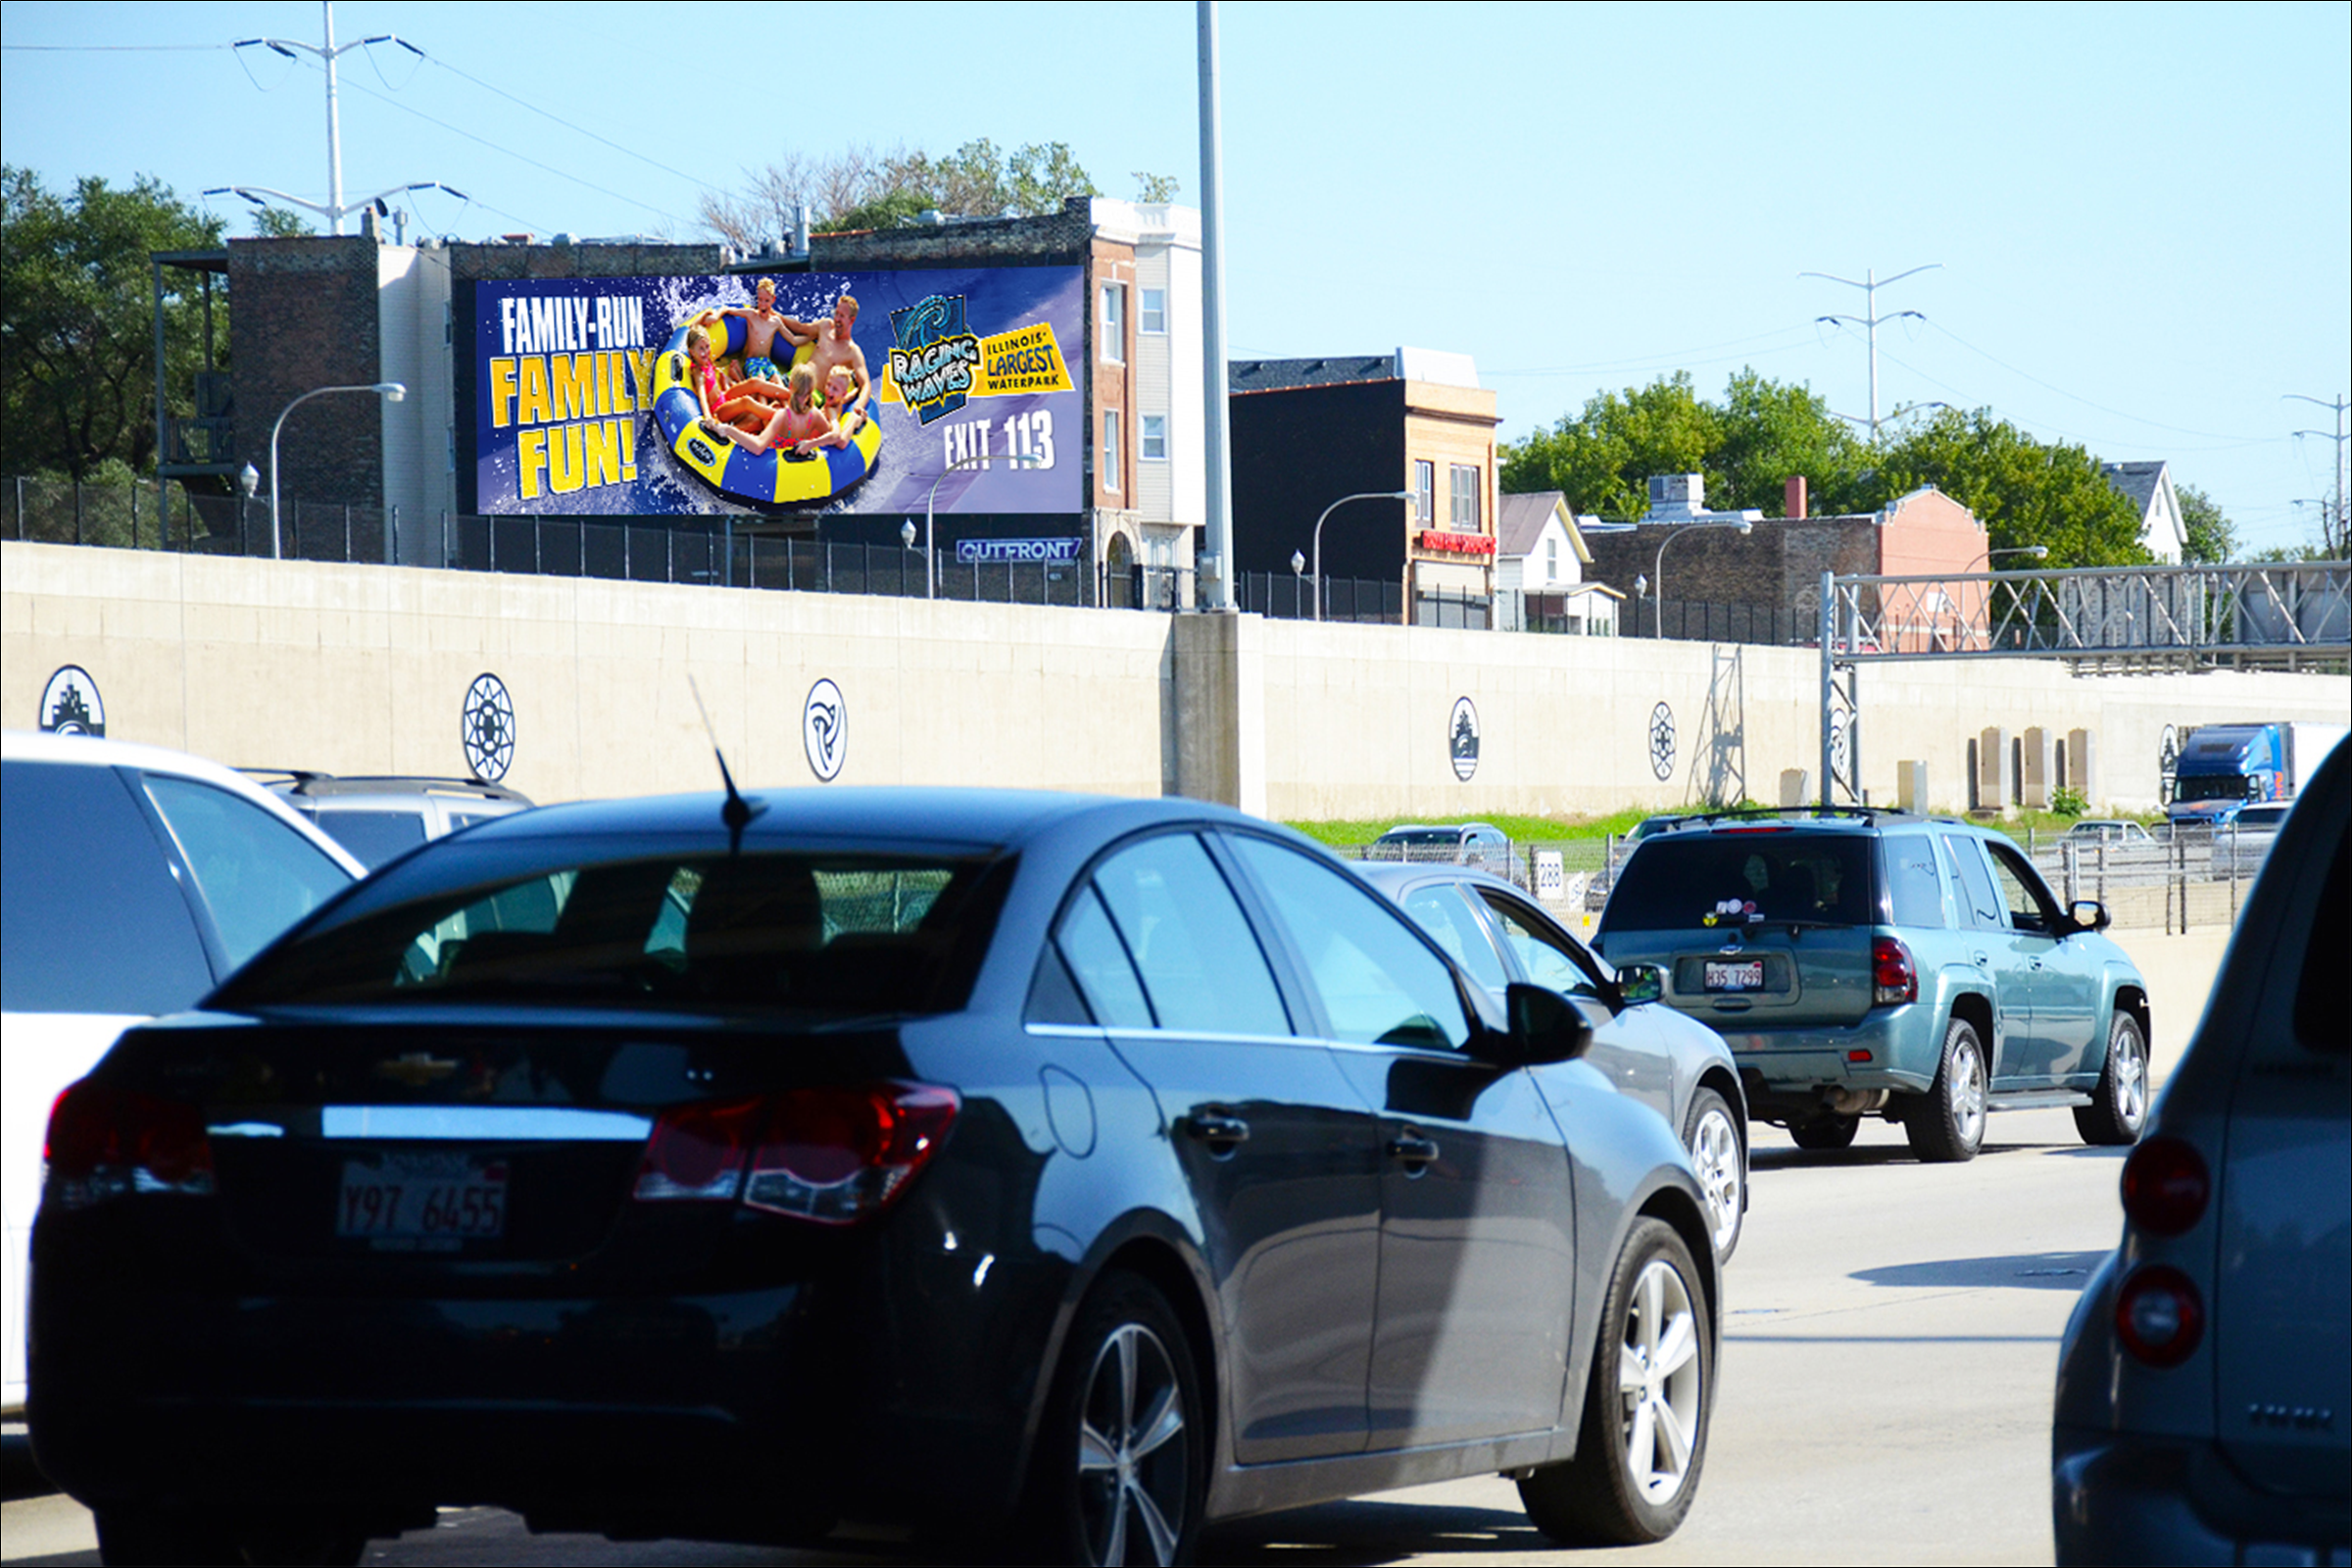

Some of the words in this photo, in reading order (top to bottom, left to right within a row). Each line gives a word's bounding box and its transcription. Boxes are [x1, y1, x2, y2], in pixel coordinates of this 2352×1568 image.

[499, 296, 644, 354] FAMILY-RUN
[893, 338, 978, 383] RAGING
[903, 360, 971, 403] WAVES
[988, 345, 1055, 377] LARGEST
[988, 374, 1059, 390] WATERPARK
[488, 347, 656, 428] FAMILY
[515, 418, 637, 500] FUN!
[944, 418, 991, 469] EXIT
[1004, 410, 1054, 469] 113
[961, 542, 1074, 559] OUTFRONT
[1540, 863, 1560, 887] 288
[1735, 970, 1761, 986] 7299
[346, 1185, 403, 1231] Y97
[421, 1186, 500, 1232] 6455
